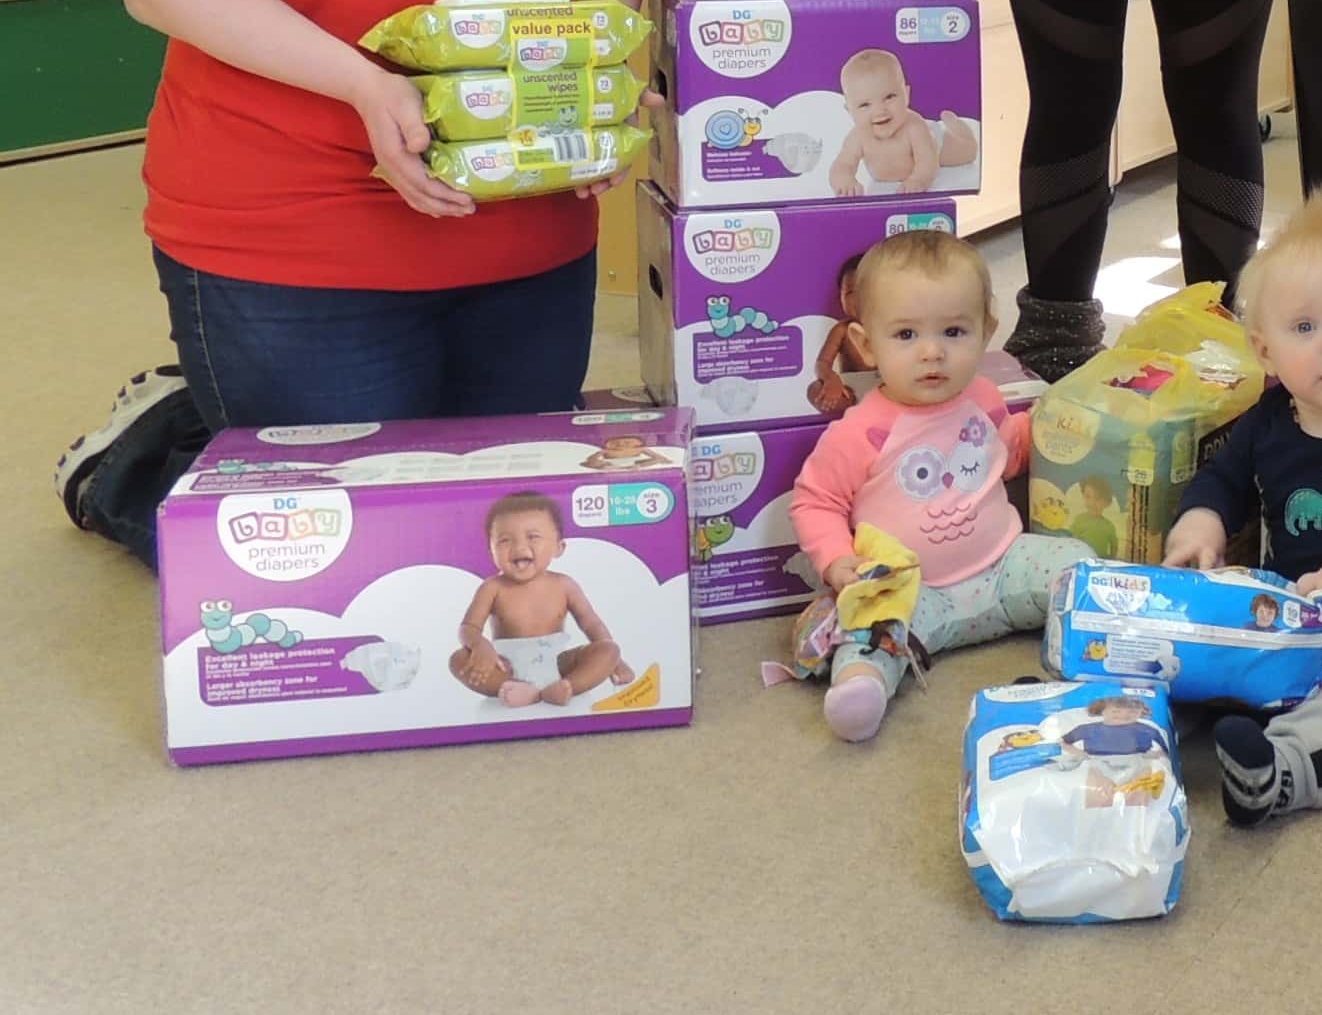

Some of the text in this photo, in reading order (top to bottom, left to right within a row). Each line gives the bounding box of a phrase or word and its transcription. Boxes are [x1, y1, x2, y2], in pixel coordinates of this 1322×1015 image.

[733, 10, 752, 20] DG
[512, 21, 592, 36] value pack
[900, 17, 917, 29] 86
[948, 21, 958, 33] 2
[702, 21, 782, 45] baby
[712, 47, 771, 59] premium
[718, 58, 767, 70] diapers
[523, 72, 578, 82] unscented
[549, 83, 578, 94] wipes
[724, 219, 742, 229] DG
[694, 229, 773, 253] baby
[705, 253, 760, 267] premium
[710, 265, 756, 276] diapers
[702, 444, 721, 455] DG
[692, 453, 755, 482] aby
[692, 481, 743, 494] emium
[273, 498, 298, 510] DG
[576, 496, 605, 512] 120
[646, 499, 657, 514] 3
[694, 494, 738, 508] apers
[231, 510, 341, 542] baby
[248, 543, 326, 561] premium
[256, 558, 320, 573] diapers
